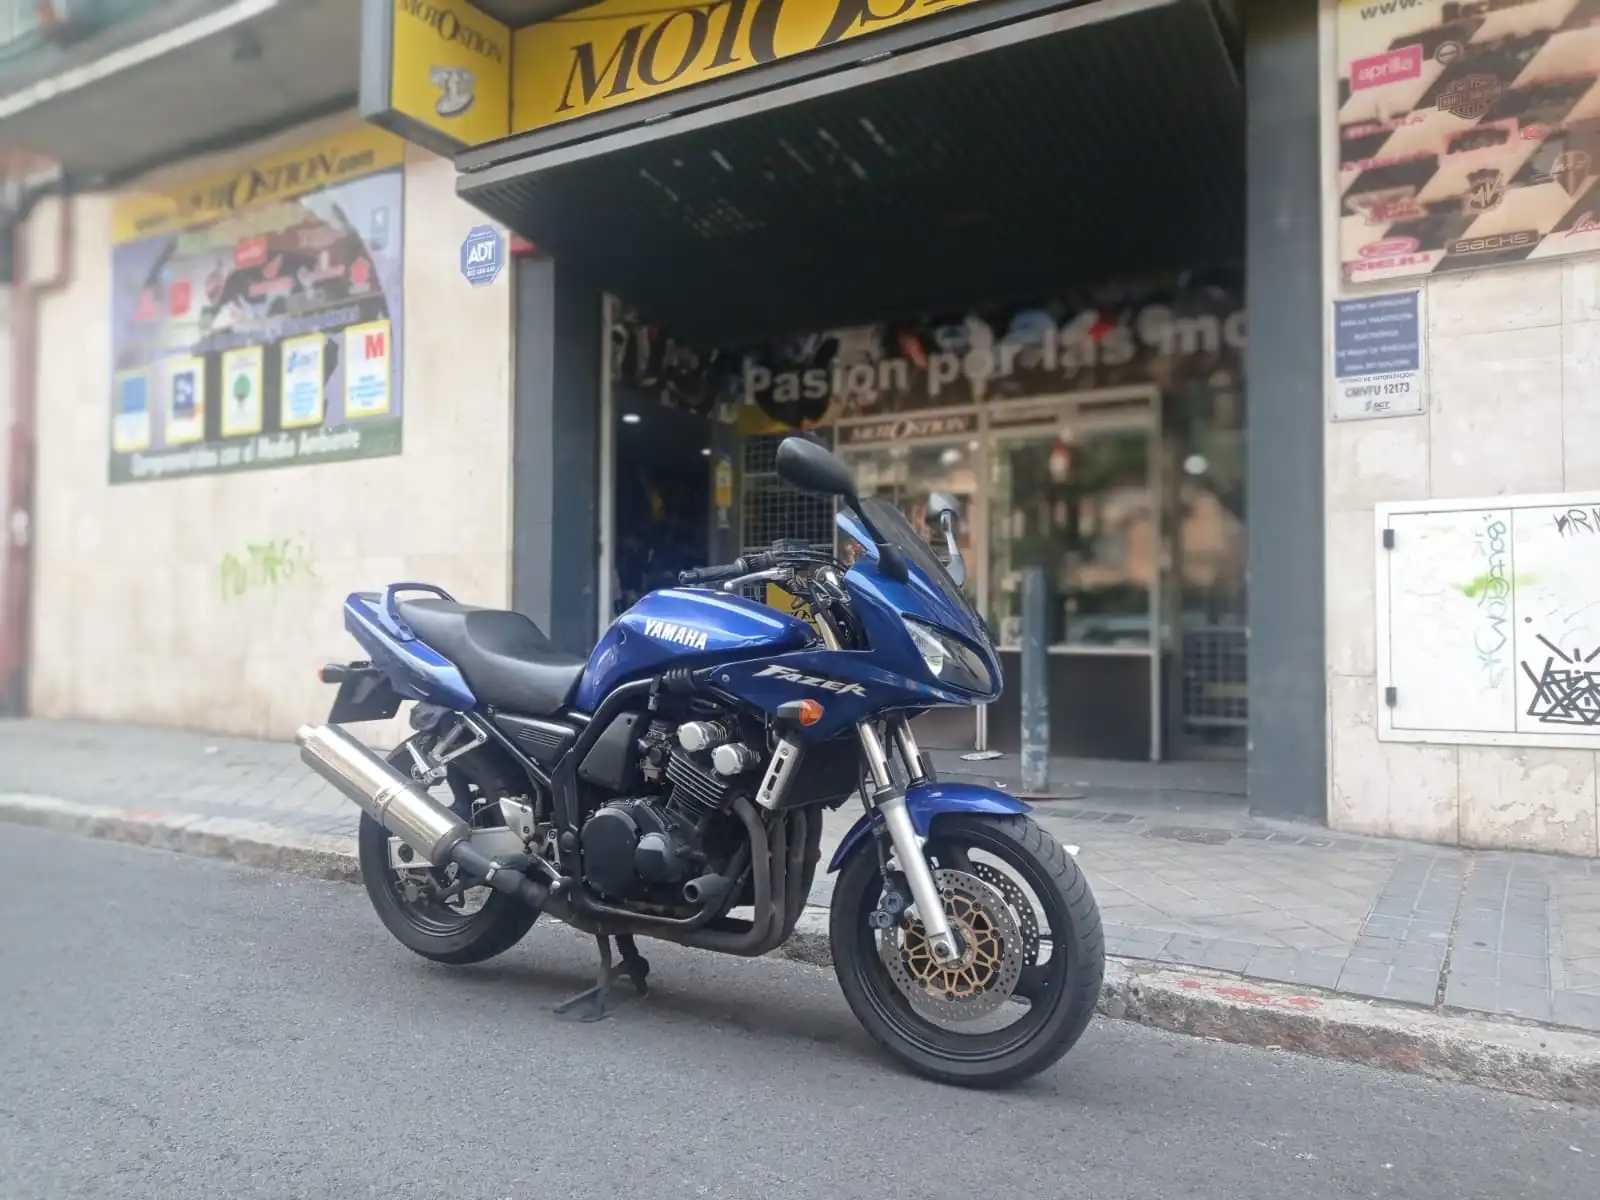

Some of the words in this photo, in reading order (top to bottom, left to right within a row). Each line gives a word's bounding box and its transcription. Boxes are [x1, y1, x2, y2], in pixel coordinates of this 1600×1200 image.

[469, 240, 495, 264] ADT
[1384, 382, 1410, 395] 12173
[644, 617, 708, 650] YAMAHA
[752, 664, 867, 697] FAZER
